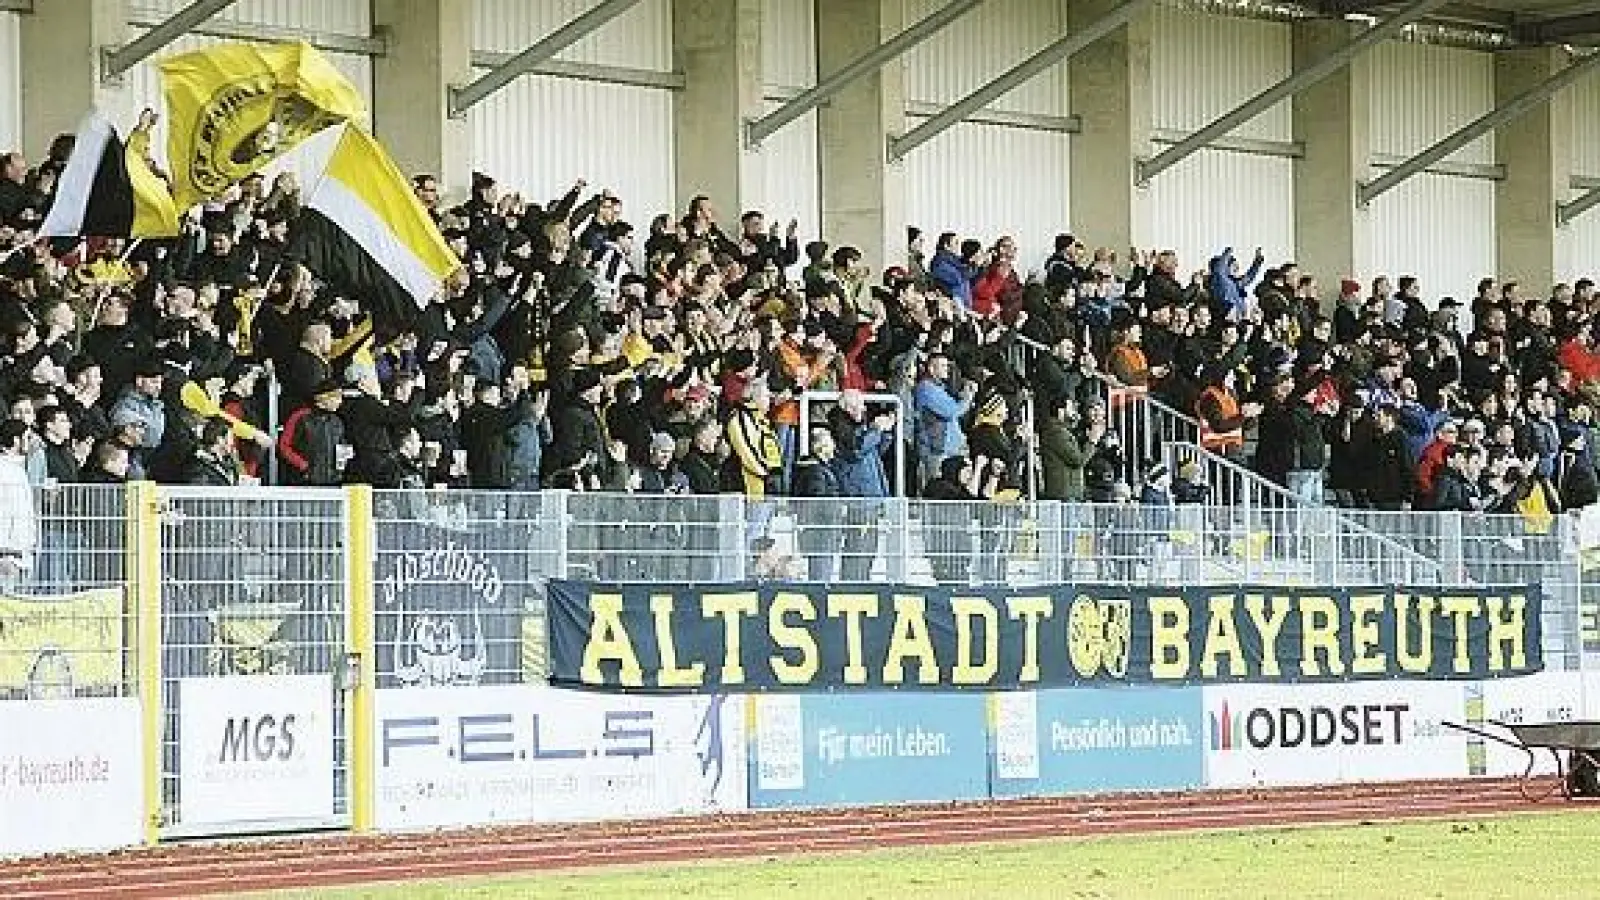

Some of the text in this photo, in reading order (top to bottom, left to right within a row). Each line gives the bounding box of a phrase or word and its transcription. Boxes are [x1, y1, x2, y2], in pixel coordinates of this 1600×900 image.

[579, 591, 1053, 687] ALTSTADT
[1148, 595, 1526, 679] BAYREUTH
[219, 714, 295, 764] MGS
[849, 725, 893, 757] mein
[896, 724, 951, 757] Leben.
[1052, 716, 1193, 751] Persönlich und nah.
[1246, 704, 1409, 748] ODDSET
